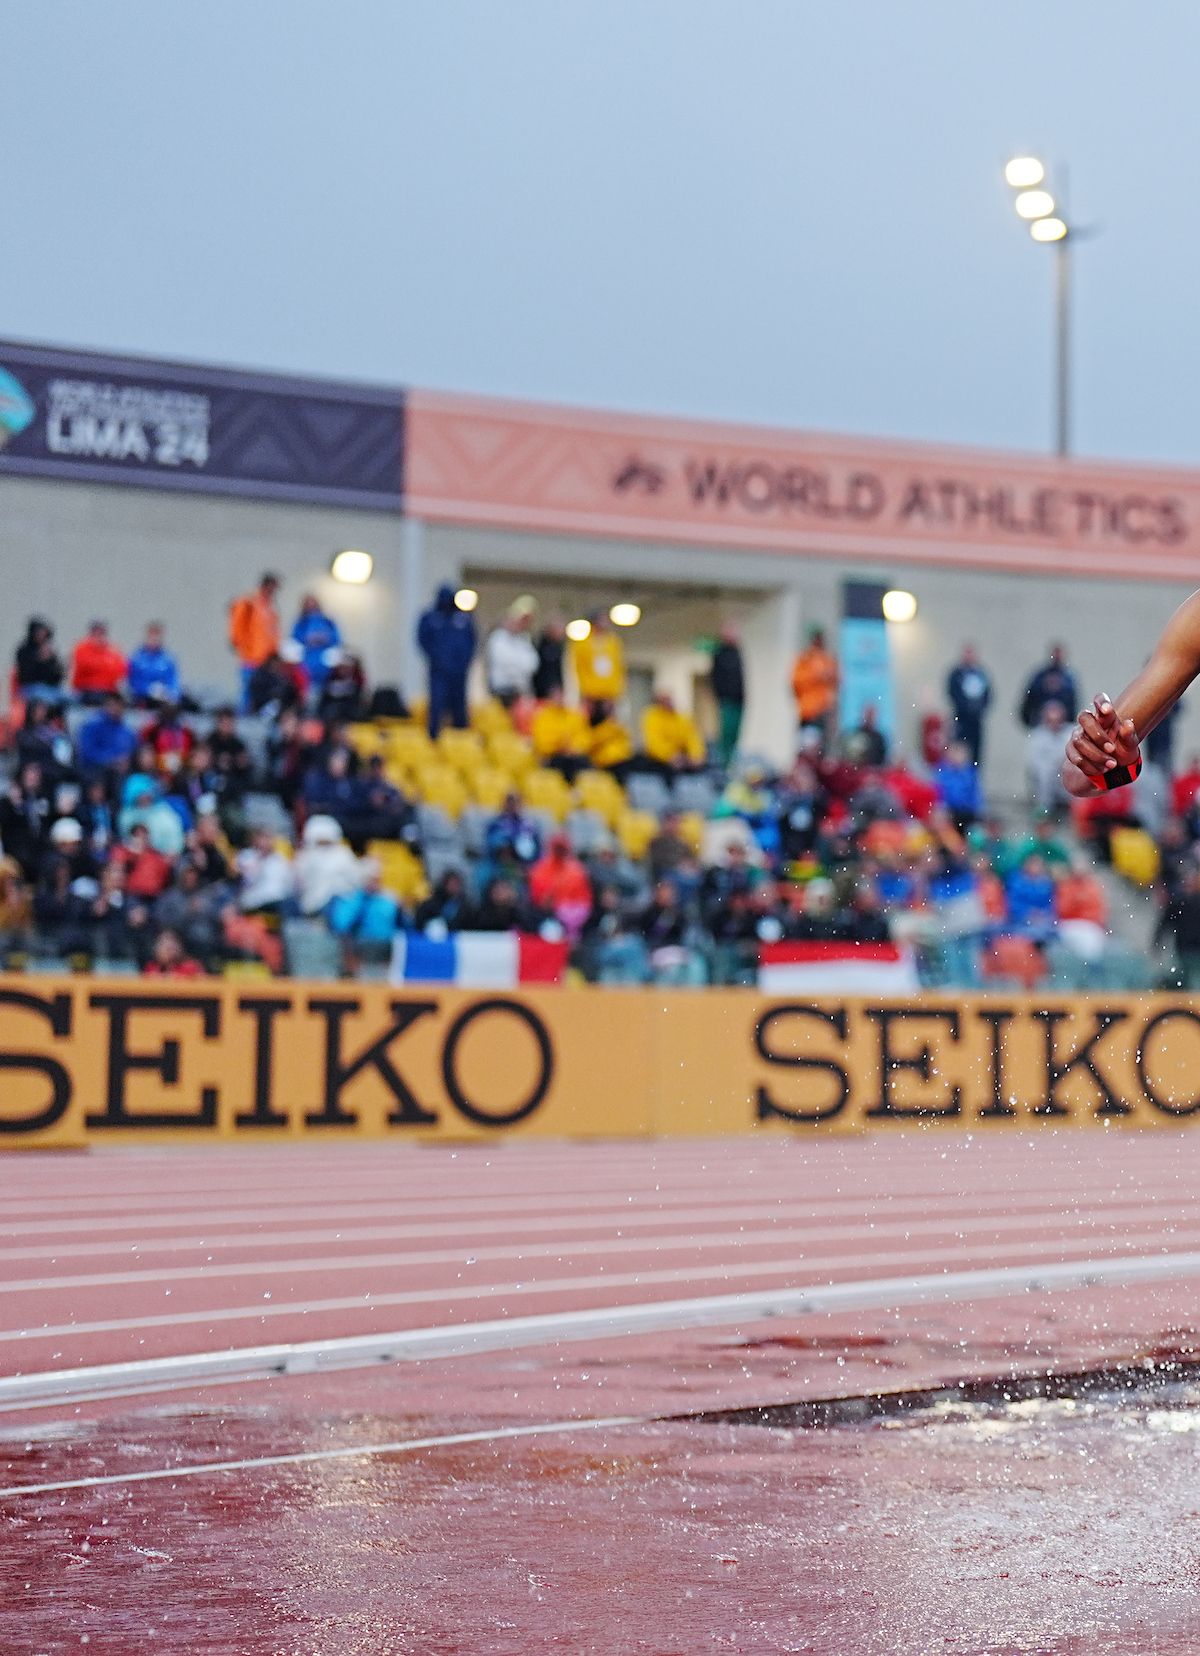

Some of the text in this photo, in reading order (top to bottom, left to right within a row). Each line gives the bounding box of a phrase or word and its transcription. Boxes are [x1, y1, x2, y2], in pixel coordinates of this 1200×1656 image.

[683, 458, 886, 521] WORLD
[896, 477, 1188, 546] ATHLETICS
[0, 990, 555, 1133] SEIKO
